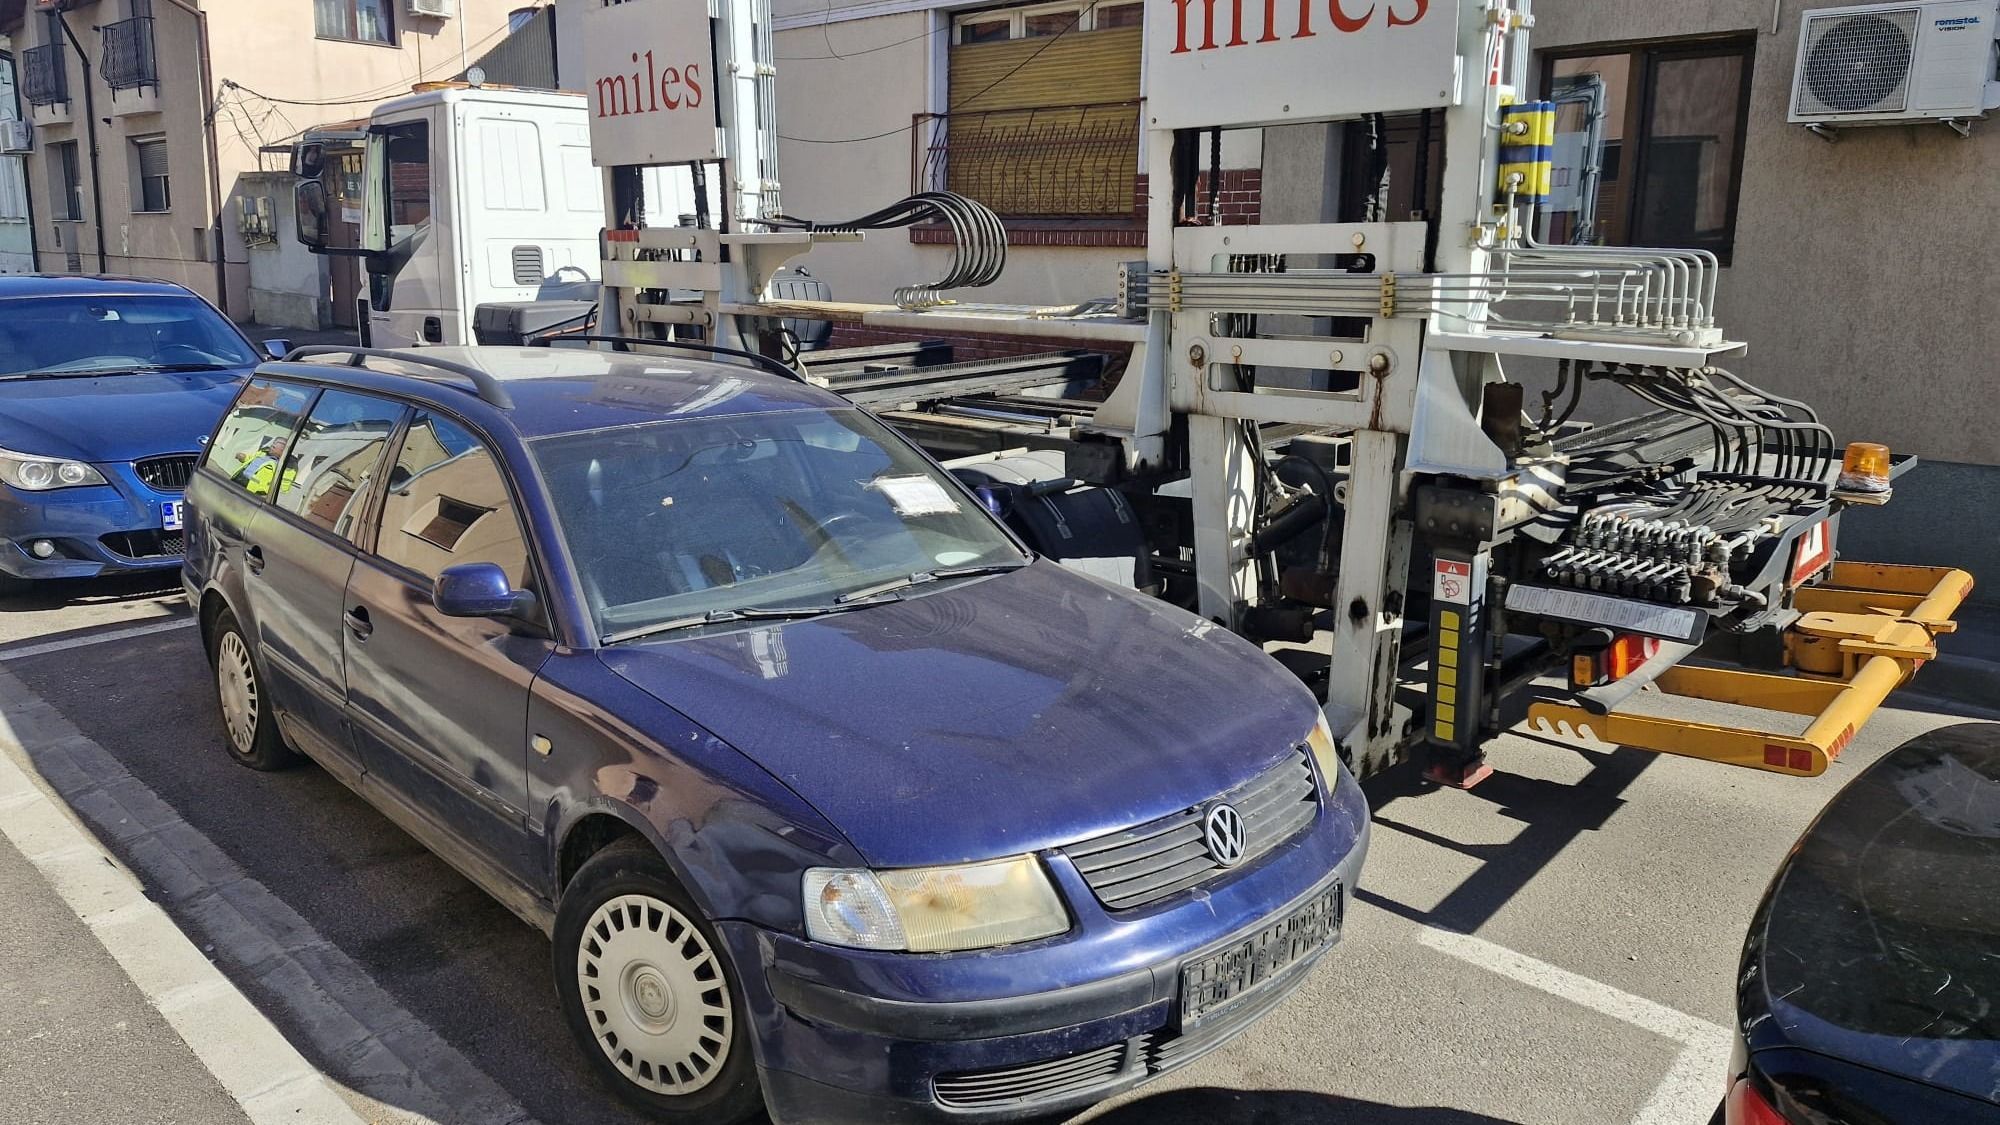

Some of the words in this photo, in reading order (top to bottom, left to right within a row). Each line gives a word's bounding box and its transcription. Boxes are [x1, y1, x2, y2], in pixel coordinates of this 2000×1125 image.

[1935, 16, 1980, 26] romstal
[595, 49, 703, 118] miles
[165, 515, 175, 523] RO
